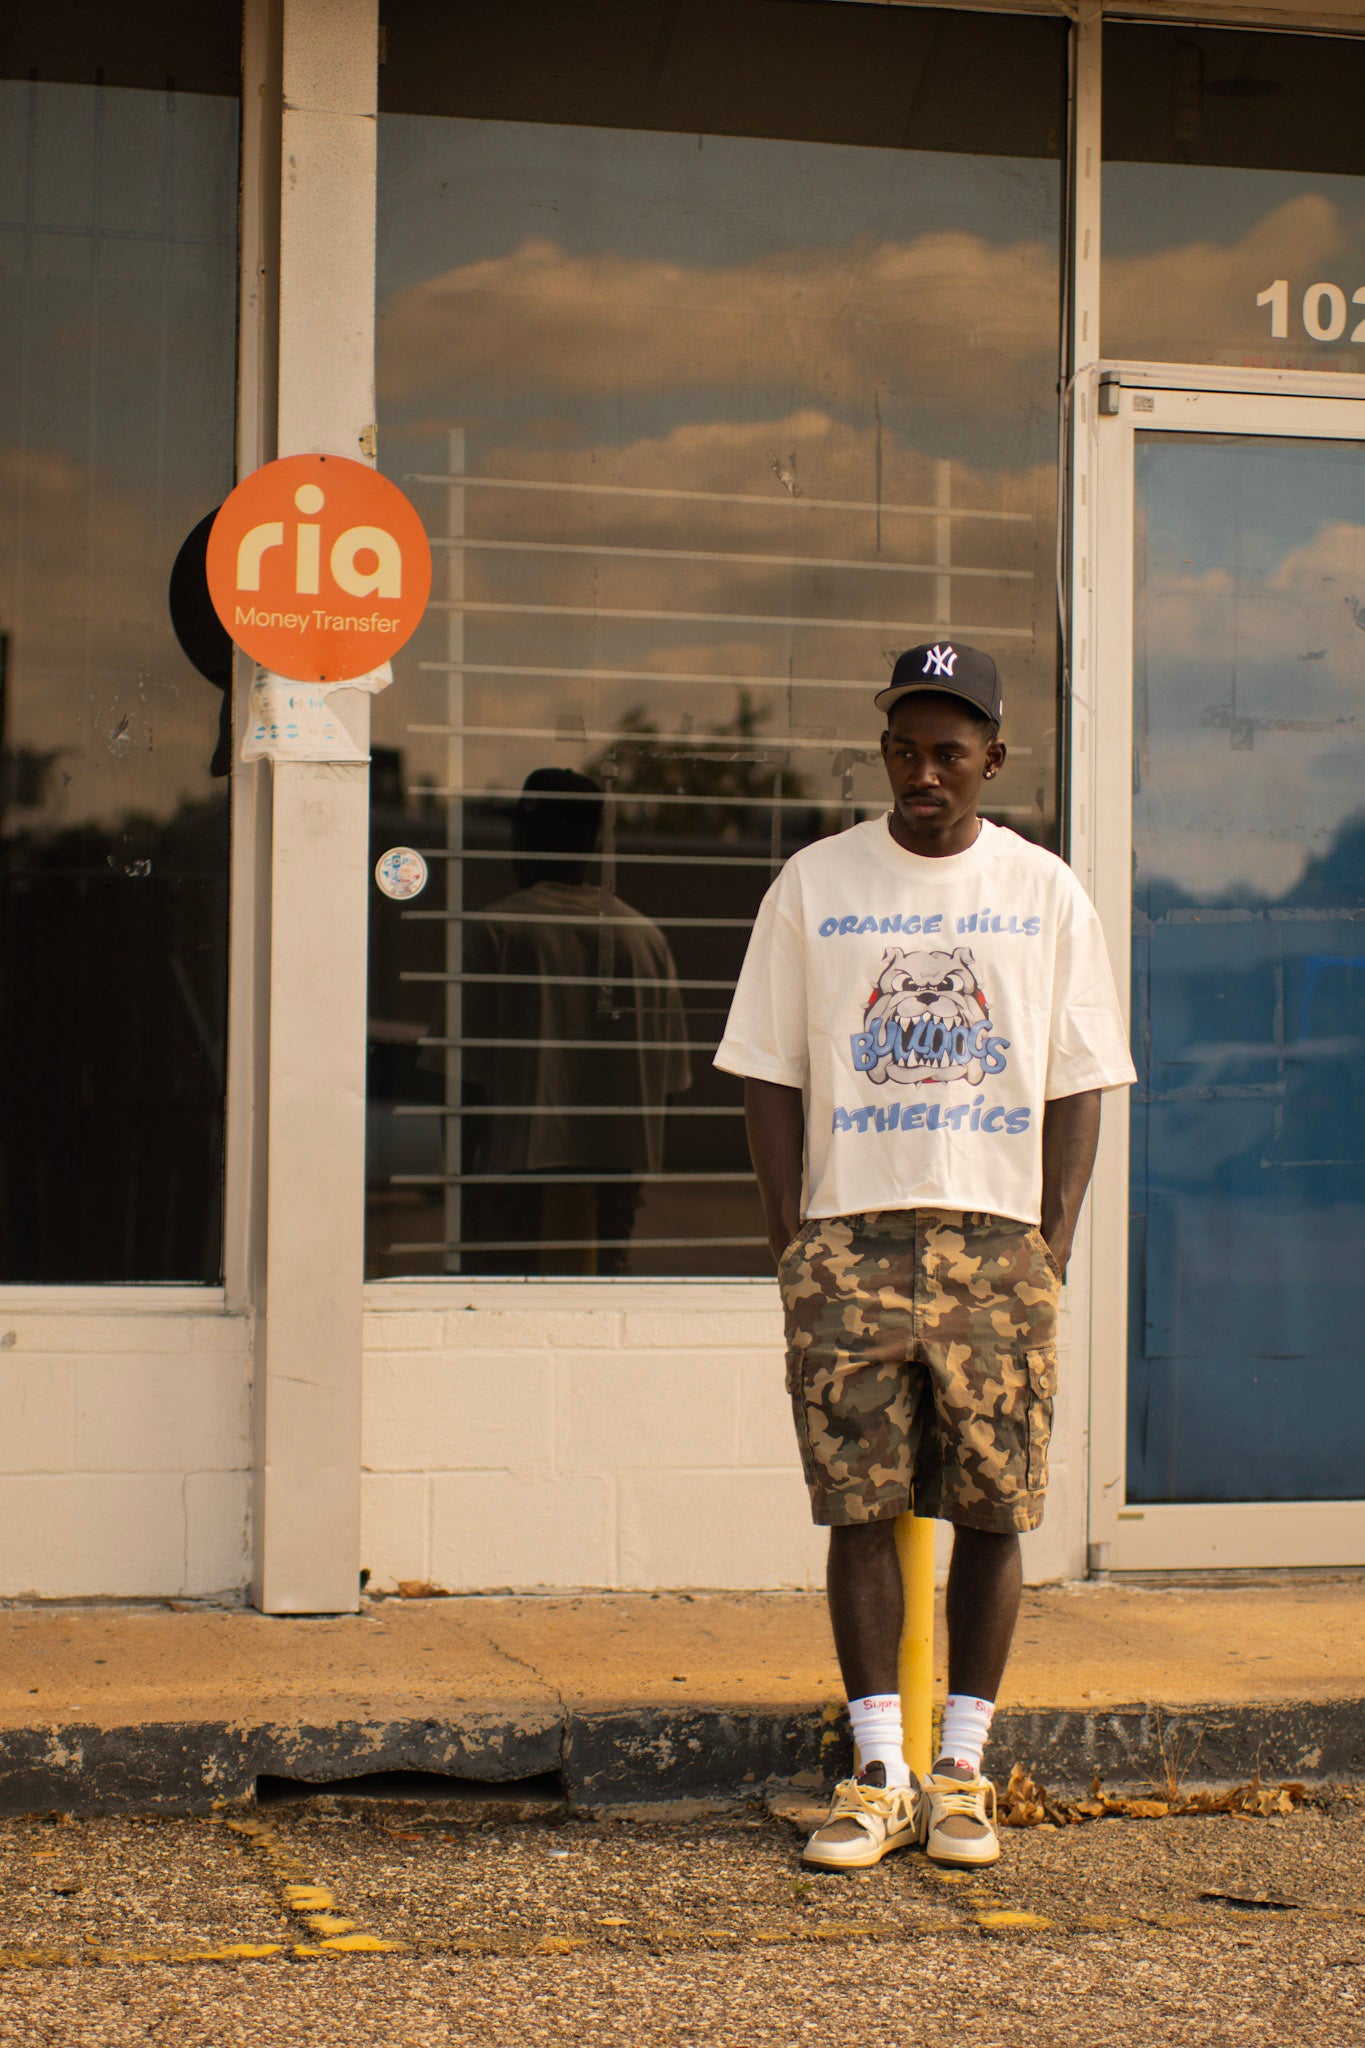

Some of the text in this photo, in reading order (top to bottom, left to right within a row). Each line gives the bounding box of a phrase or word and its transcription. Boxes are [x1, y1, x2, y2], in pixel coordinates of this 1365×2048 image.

[236, 484, 402, 599] ria
[235, 606, 400, 634] Money Transfer
[922, 645, 958, 676] NY
[818, 914, 943, 938] ORANGE
[849, 1015, 1011, 1075] BULLDOGS
